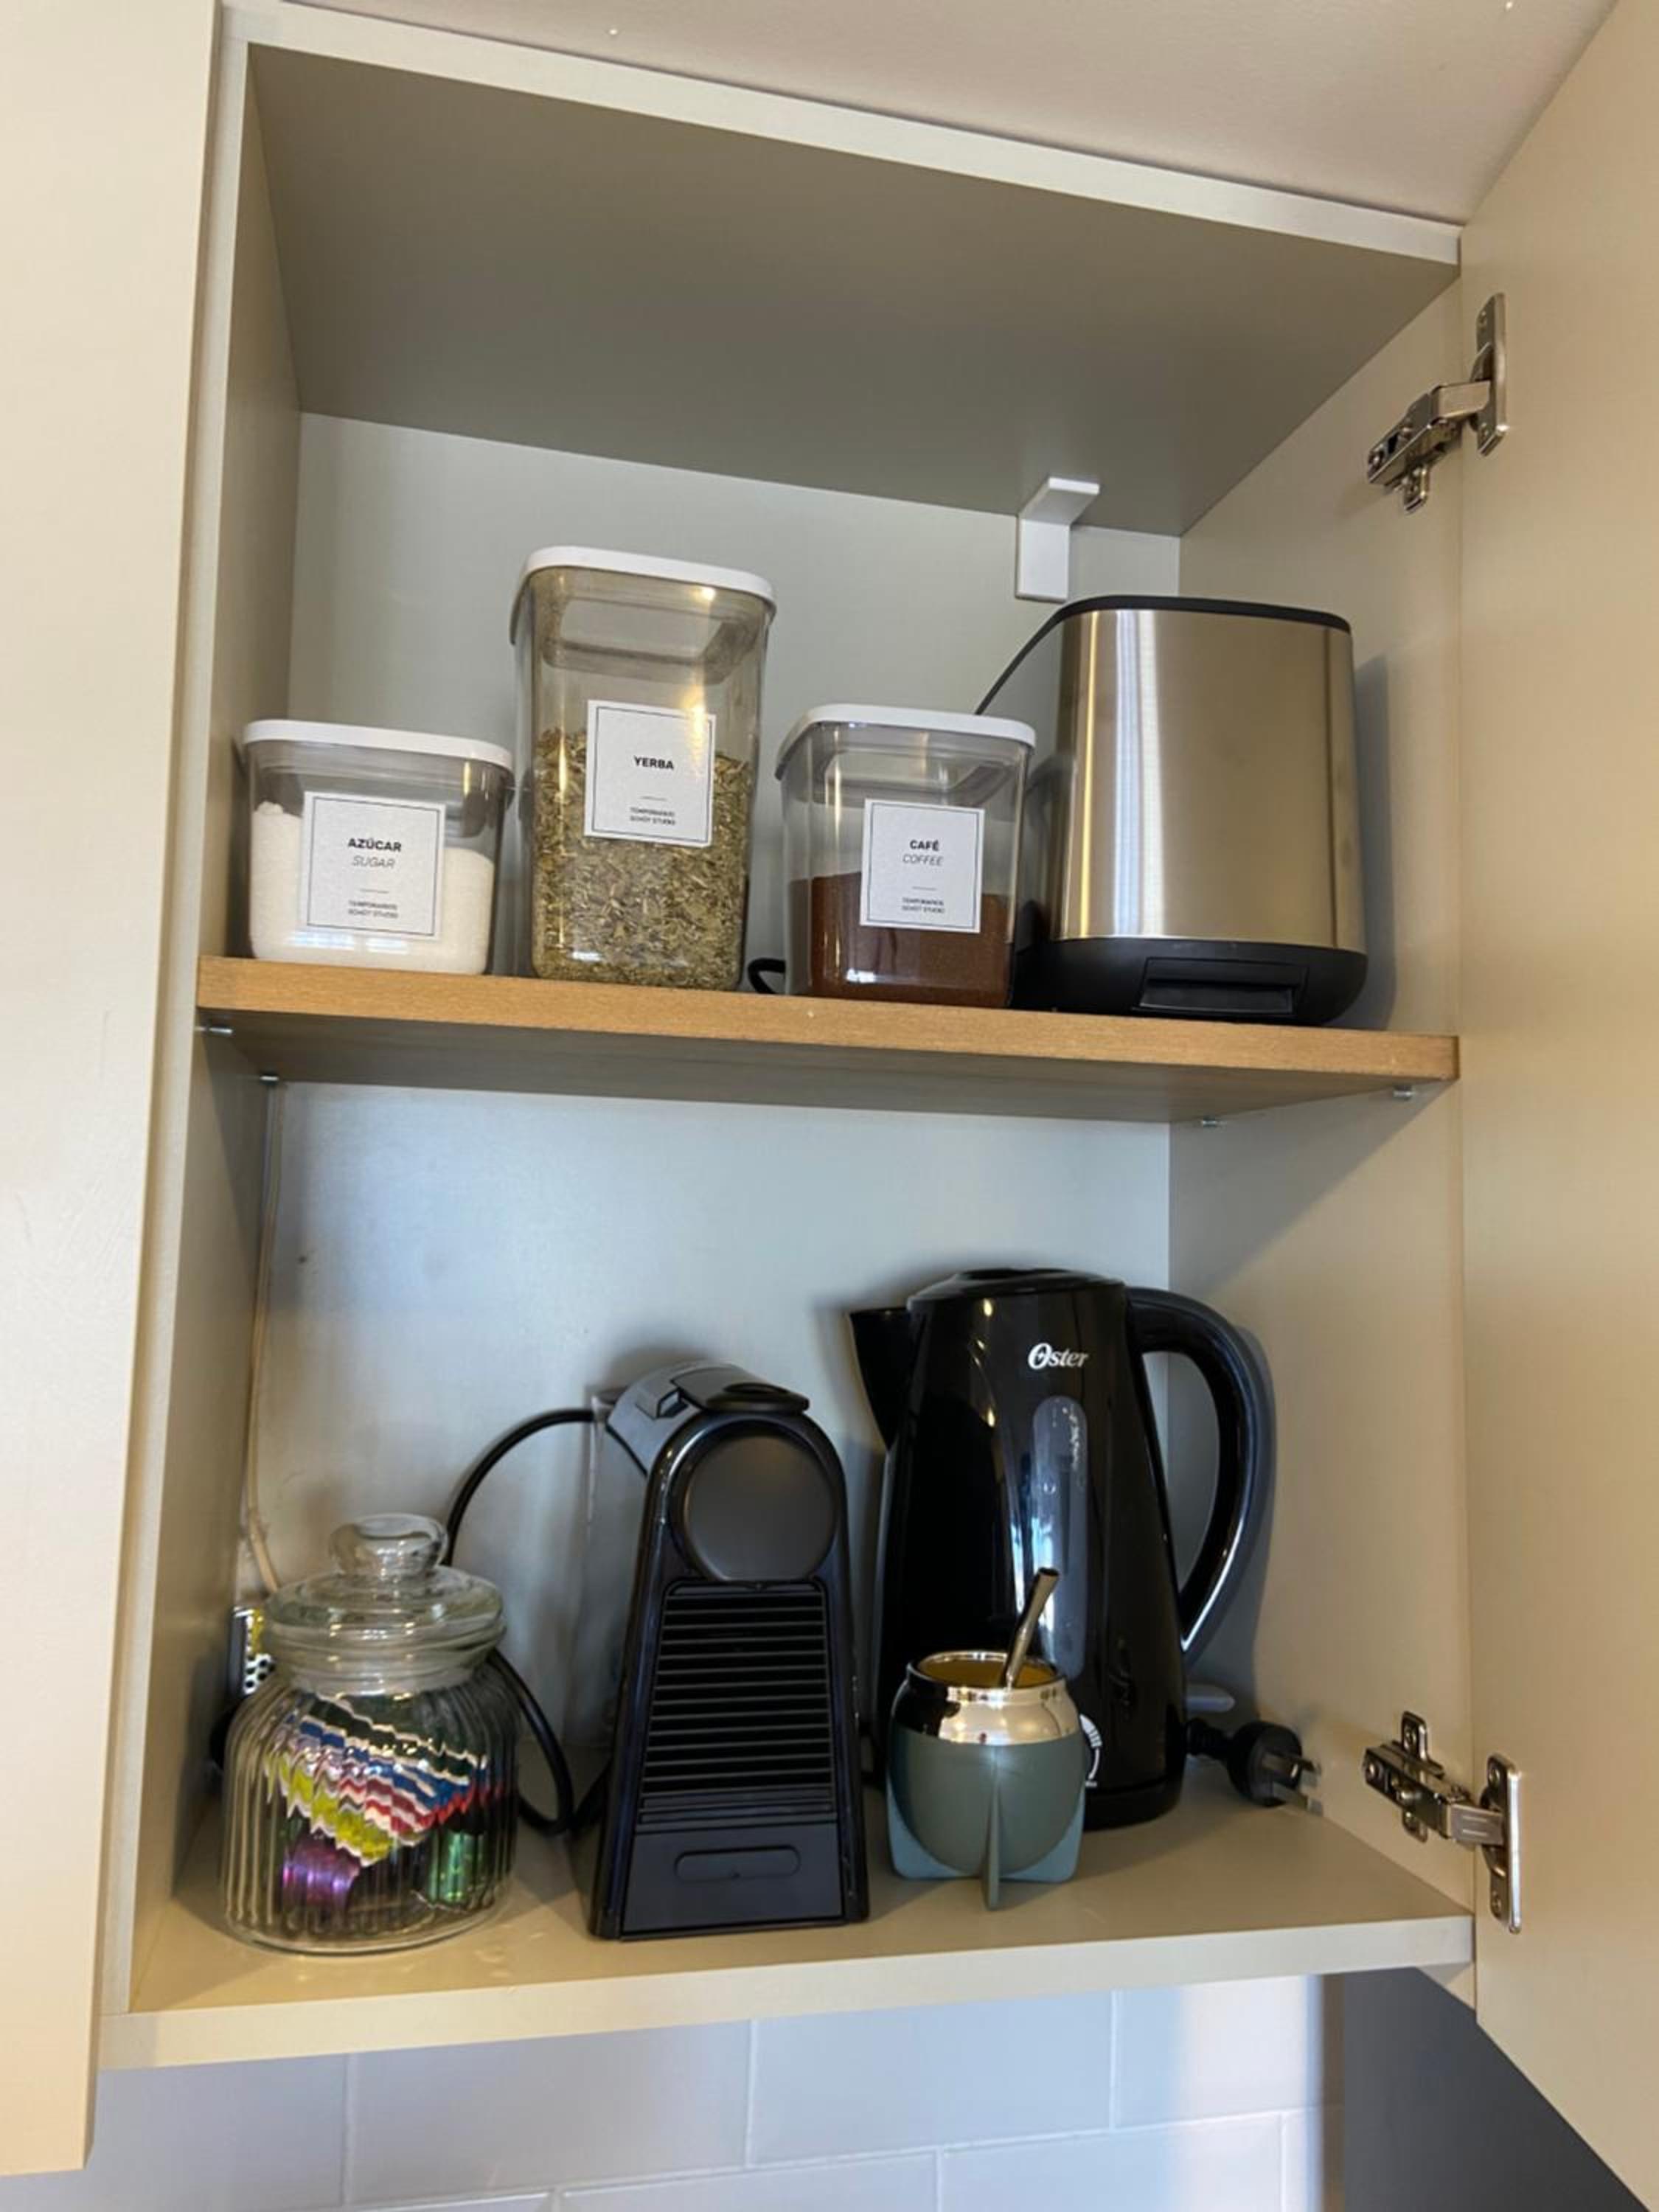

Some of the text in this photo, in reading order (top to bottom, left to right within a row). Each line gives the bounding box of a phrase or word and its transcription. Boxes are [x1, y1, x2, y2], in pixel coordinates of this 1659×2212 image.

[634, 756, 674, 770] YERBA
[348, 837, 402, 852] AZÚCAR
[910, 839, 939, 851] CAFÉ
[352, 855, 395, 869] SUGAR
[902, 853, 943, 866] COFFEE
[1028, 1343, 1088, 1370] Oster
